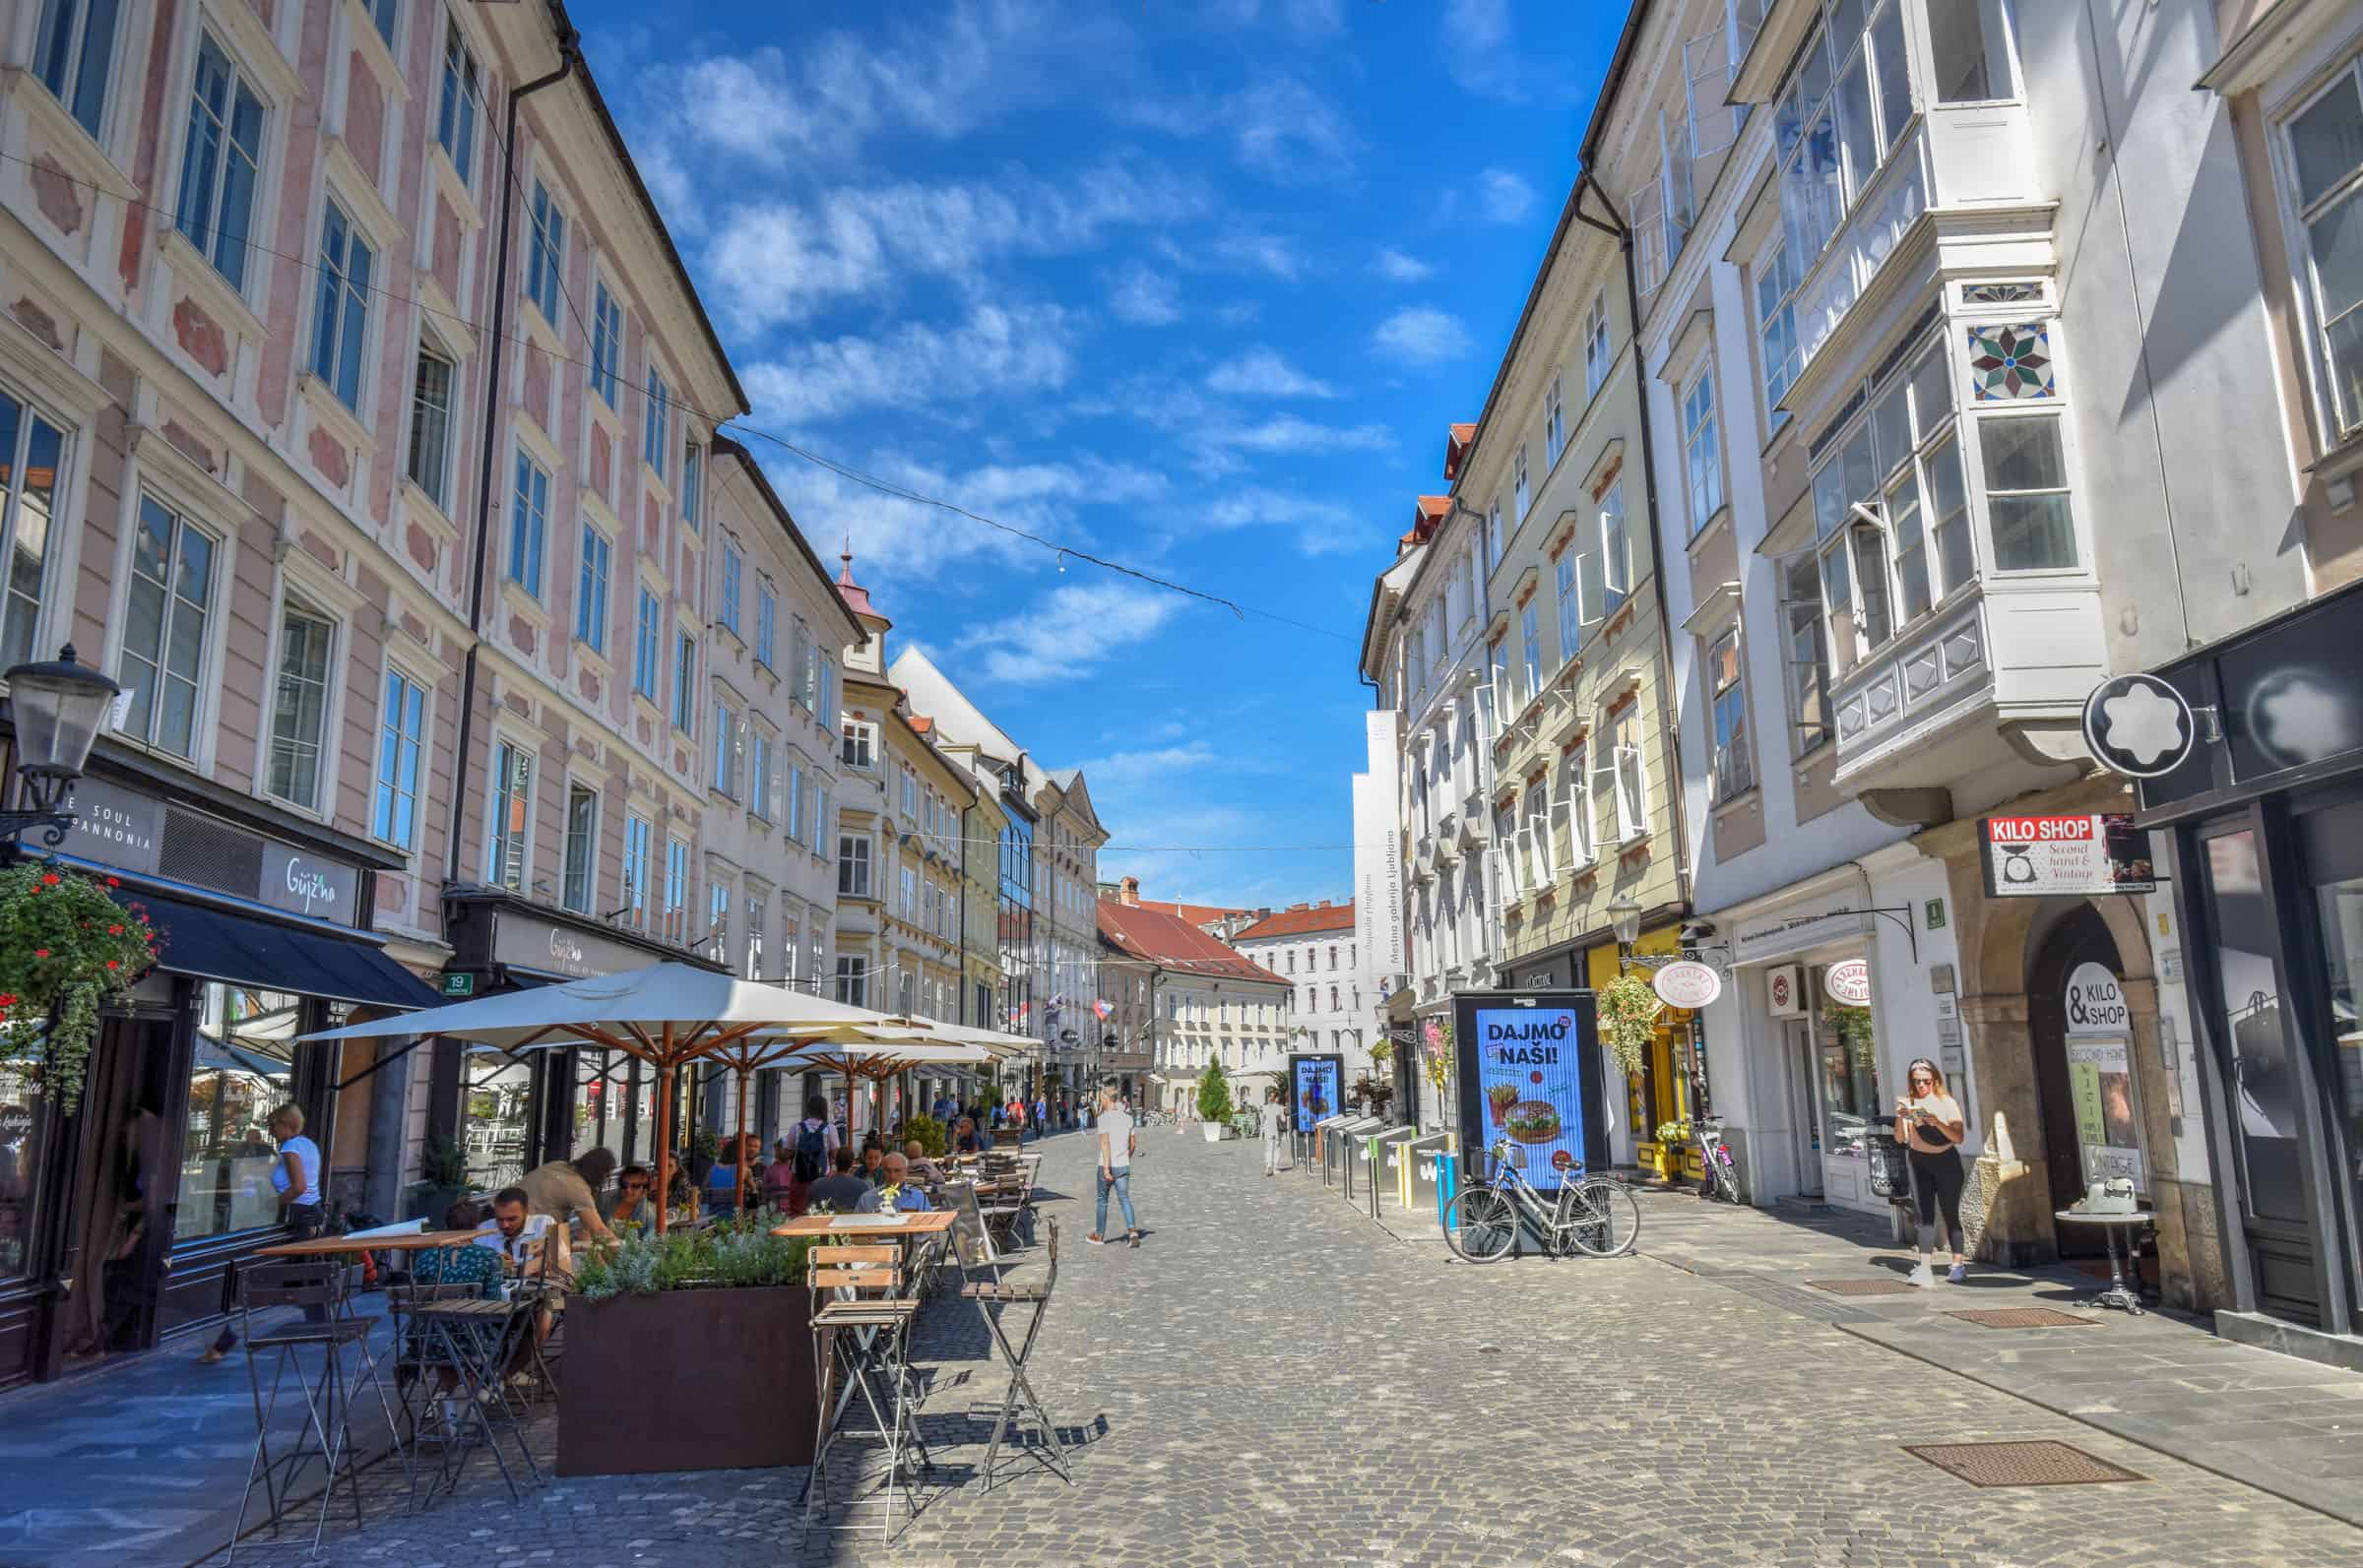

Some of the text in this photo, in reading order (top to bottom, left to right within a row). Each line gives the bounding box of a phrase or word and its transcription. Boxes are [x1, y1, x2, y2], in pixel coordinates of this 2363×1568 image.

[93, 804, 132, 827] SOUL
[1992, 819, 2089, 841] KILO SHOP
[1385, 829, 1398, 879] Ljubljana
[2048, 843, 2088, 854] Second
[2049, 854, 2091, 866] hand &
[1387, 881, 1399, 922] galerija
[450, 975, 464, 988] 19
[2070, 982, 2117, 1025] & KILO
[2089, 1005, 2126, 1025] SHOP
[1488, 1023, 1566, 1040] DAJMO
[1500, 1040, 1559, 1064] NAŠI!
